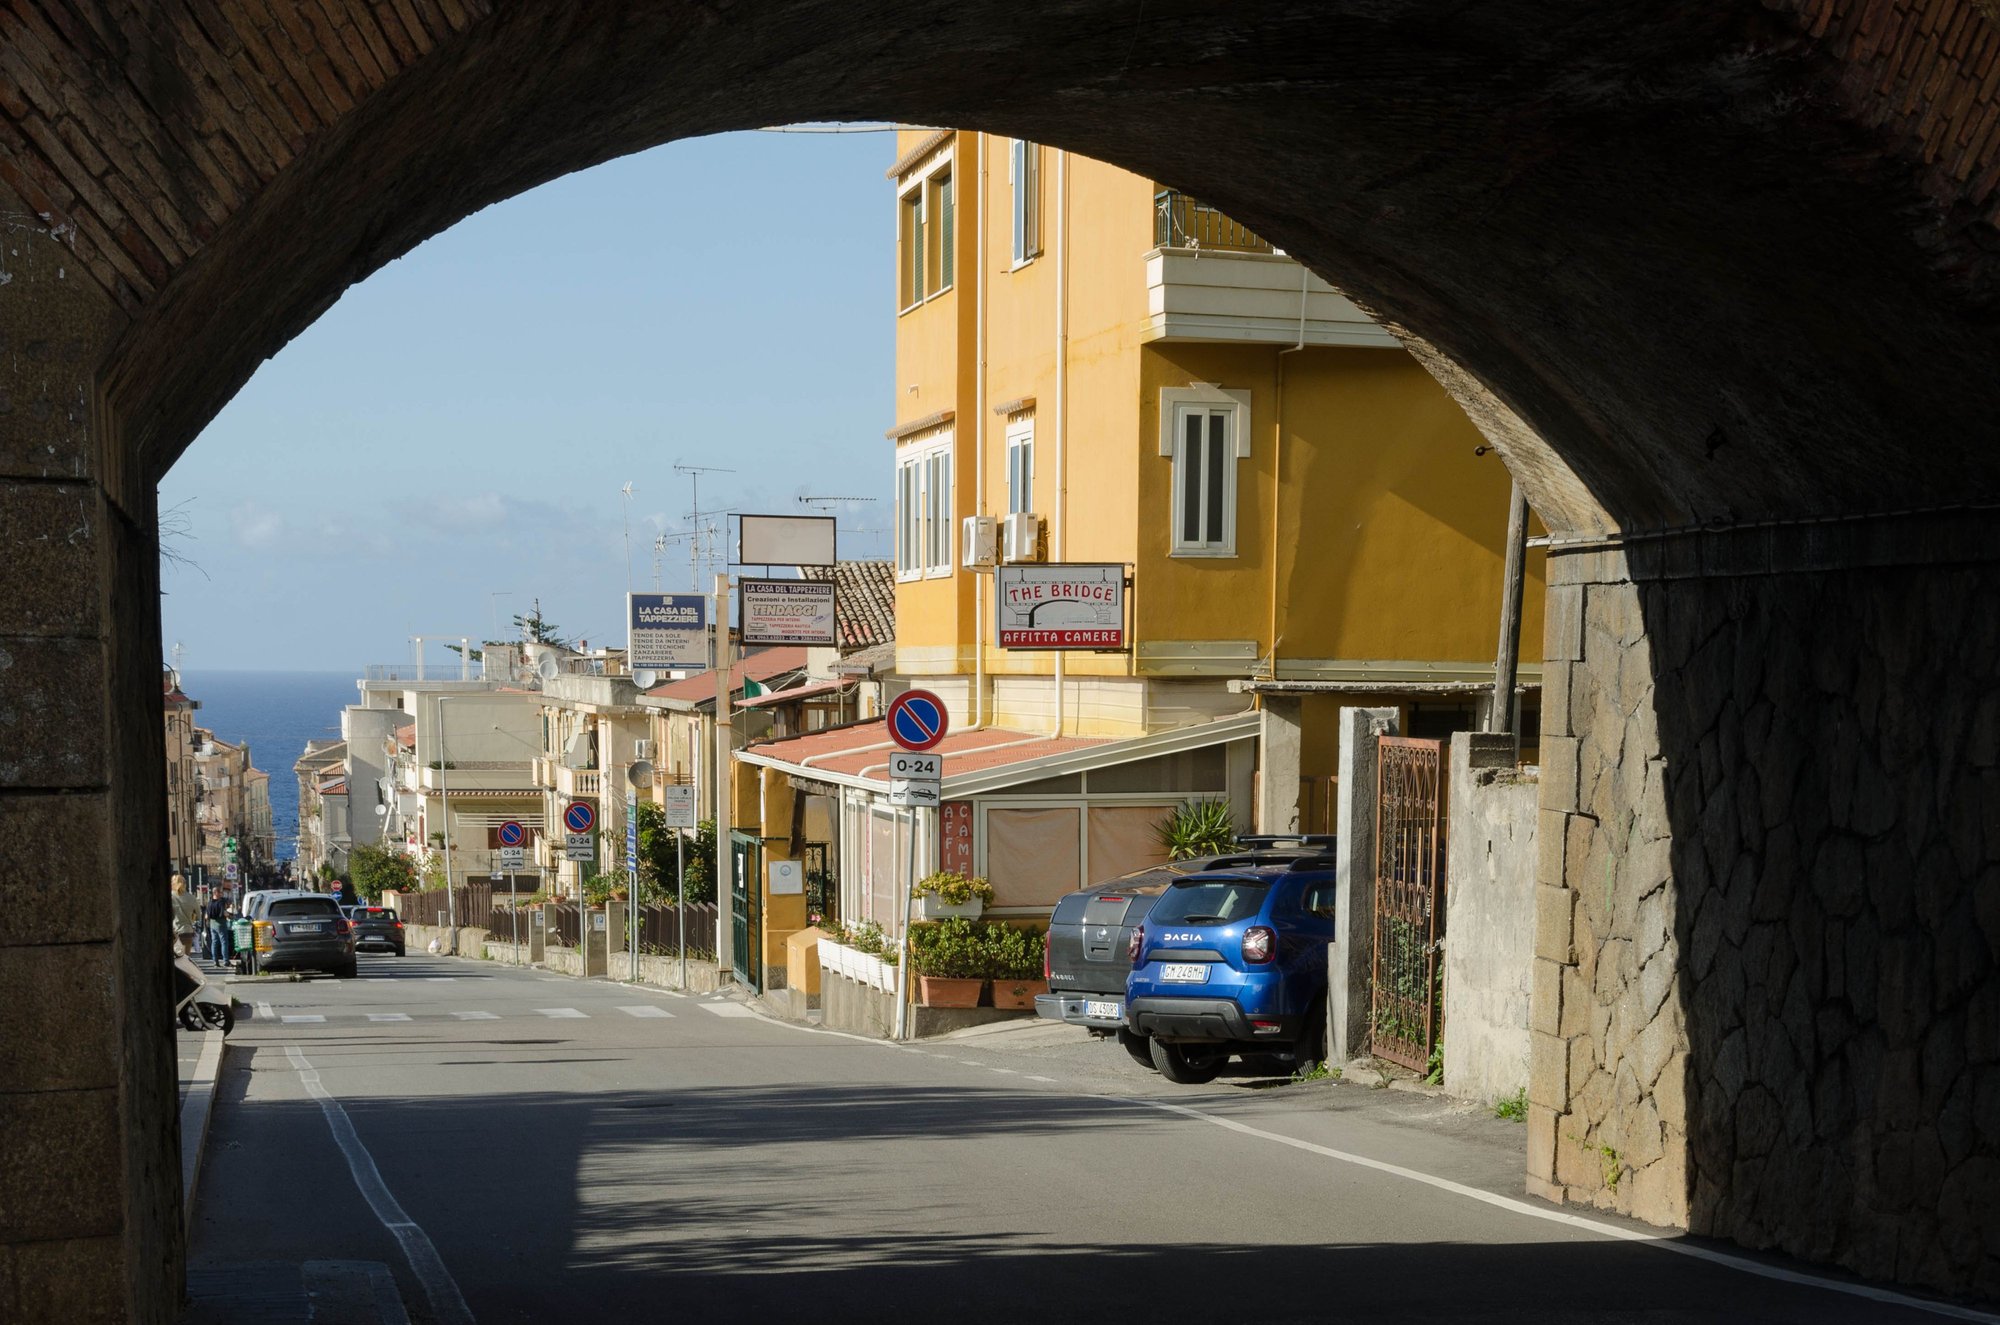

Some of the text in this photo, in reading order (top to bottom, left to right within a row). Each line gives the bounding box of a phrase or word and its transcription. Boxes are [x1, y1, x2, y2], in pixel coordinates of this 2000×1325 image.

[757, 585, 774, 593] CASA
[789, 586, 830, 595] TAPPEZZIERE
[1009, 584, 1113, 602] THE BRIDGE
[639, 607, 652, 615] LA
[753, 605, 817, 616] TENDAGGI
[639, 615, 698, 623] TAPPEZZIERE
[1003, 632, 1118, 642] AFFITTA CAMERE
[896, 759, 934, 773] 0-24
[1164, 933, 1203, 941] DACIA
[1165, 964, 1204, 979] GM 248MH
